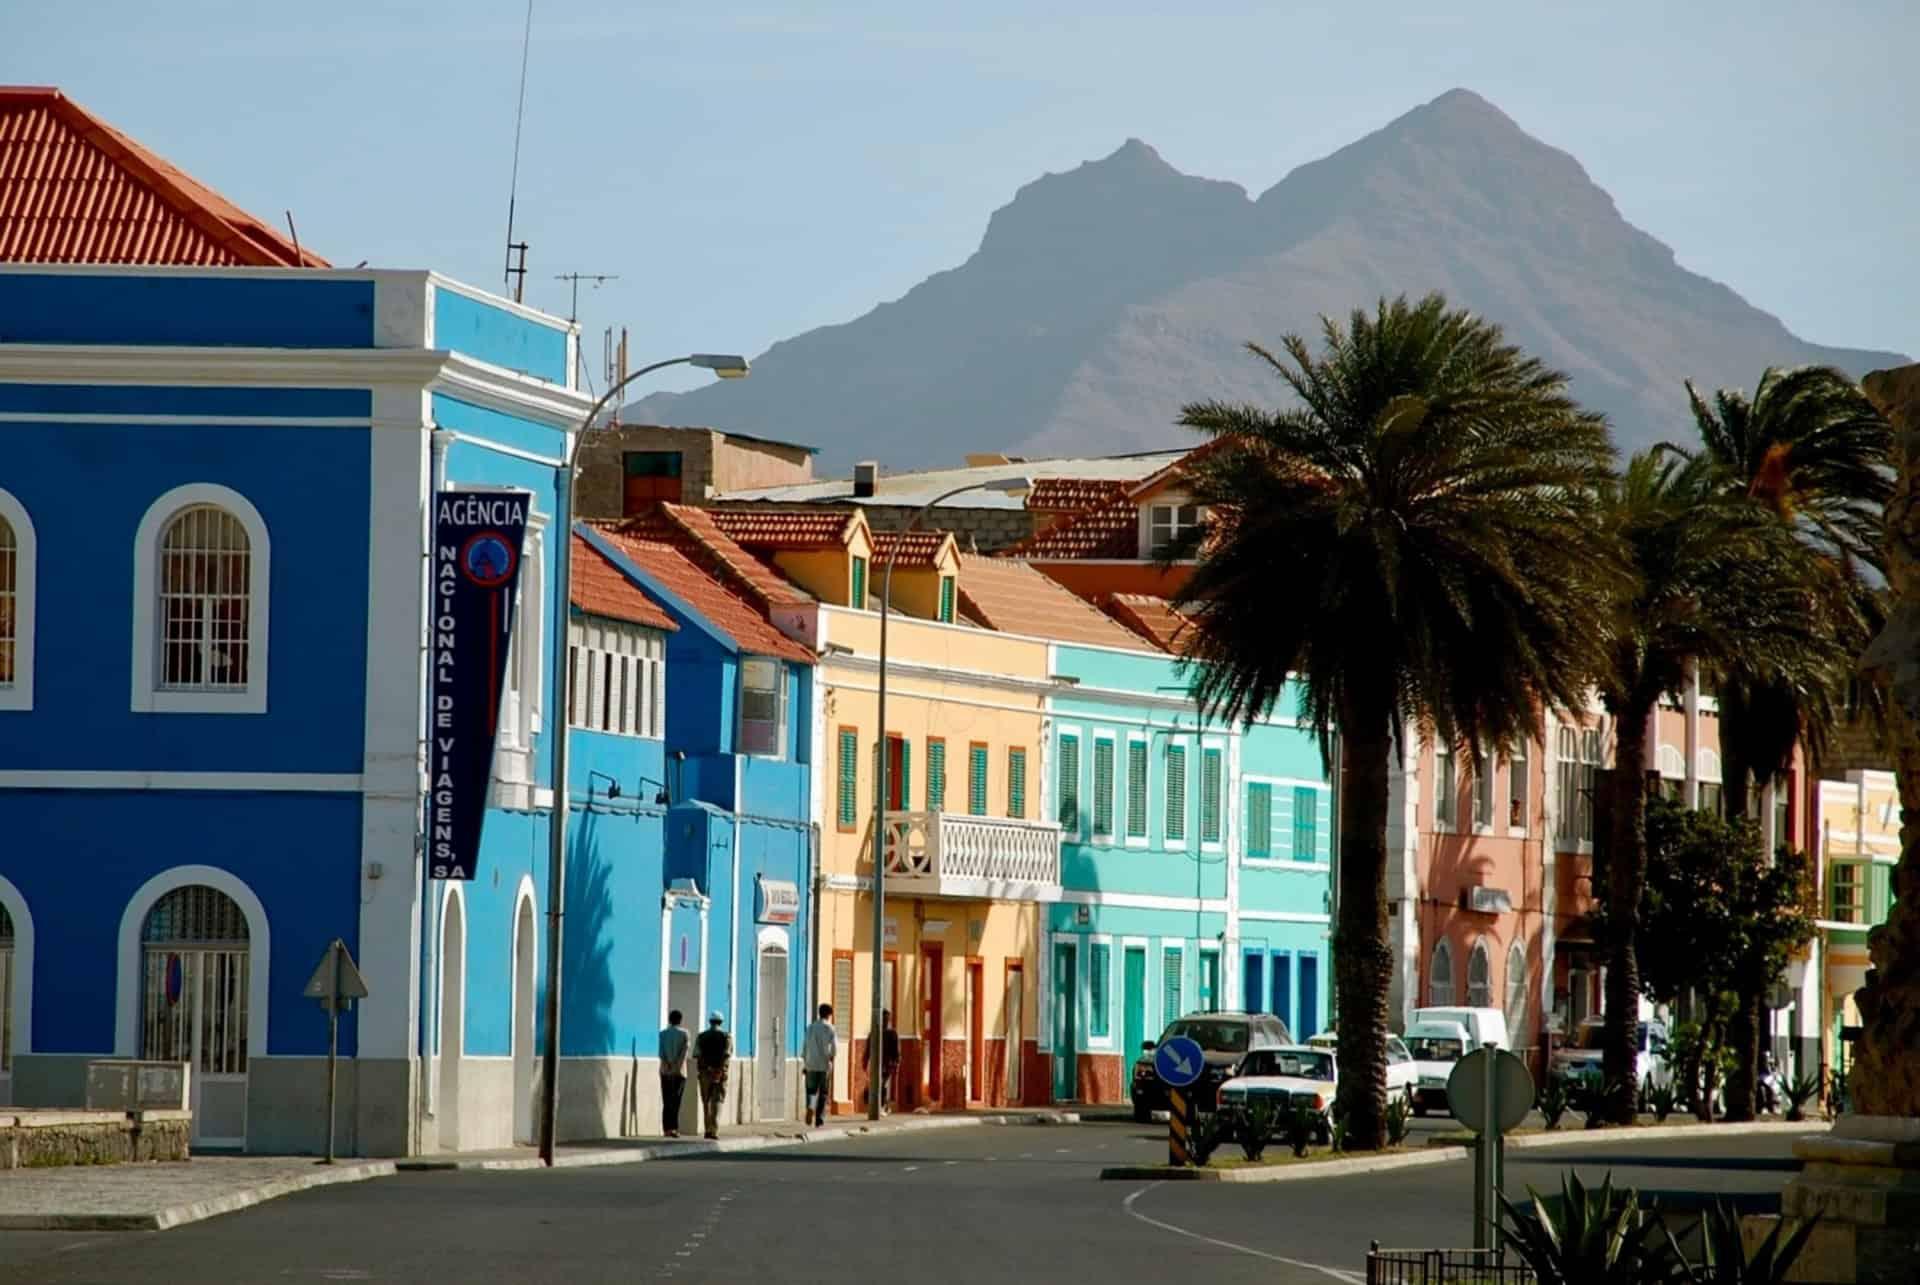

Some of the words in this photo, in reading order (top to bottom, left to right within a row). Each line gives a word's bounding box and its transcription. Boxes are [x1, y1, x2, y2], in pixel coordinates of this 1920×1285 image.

[439, 495, 524, 525] AGÊNCIA
[438, 546, 456, 682] NACIONAL
[438, 696, 454, 727] DE
[435, 737, 456, 861] VIAGENS,
